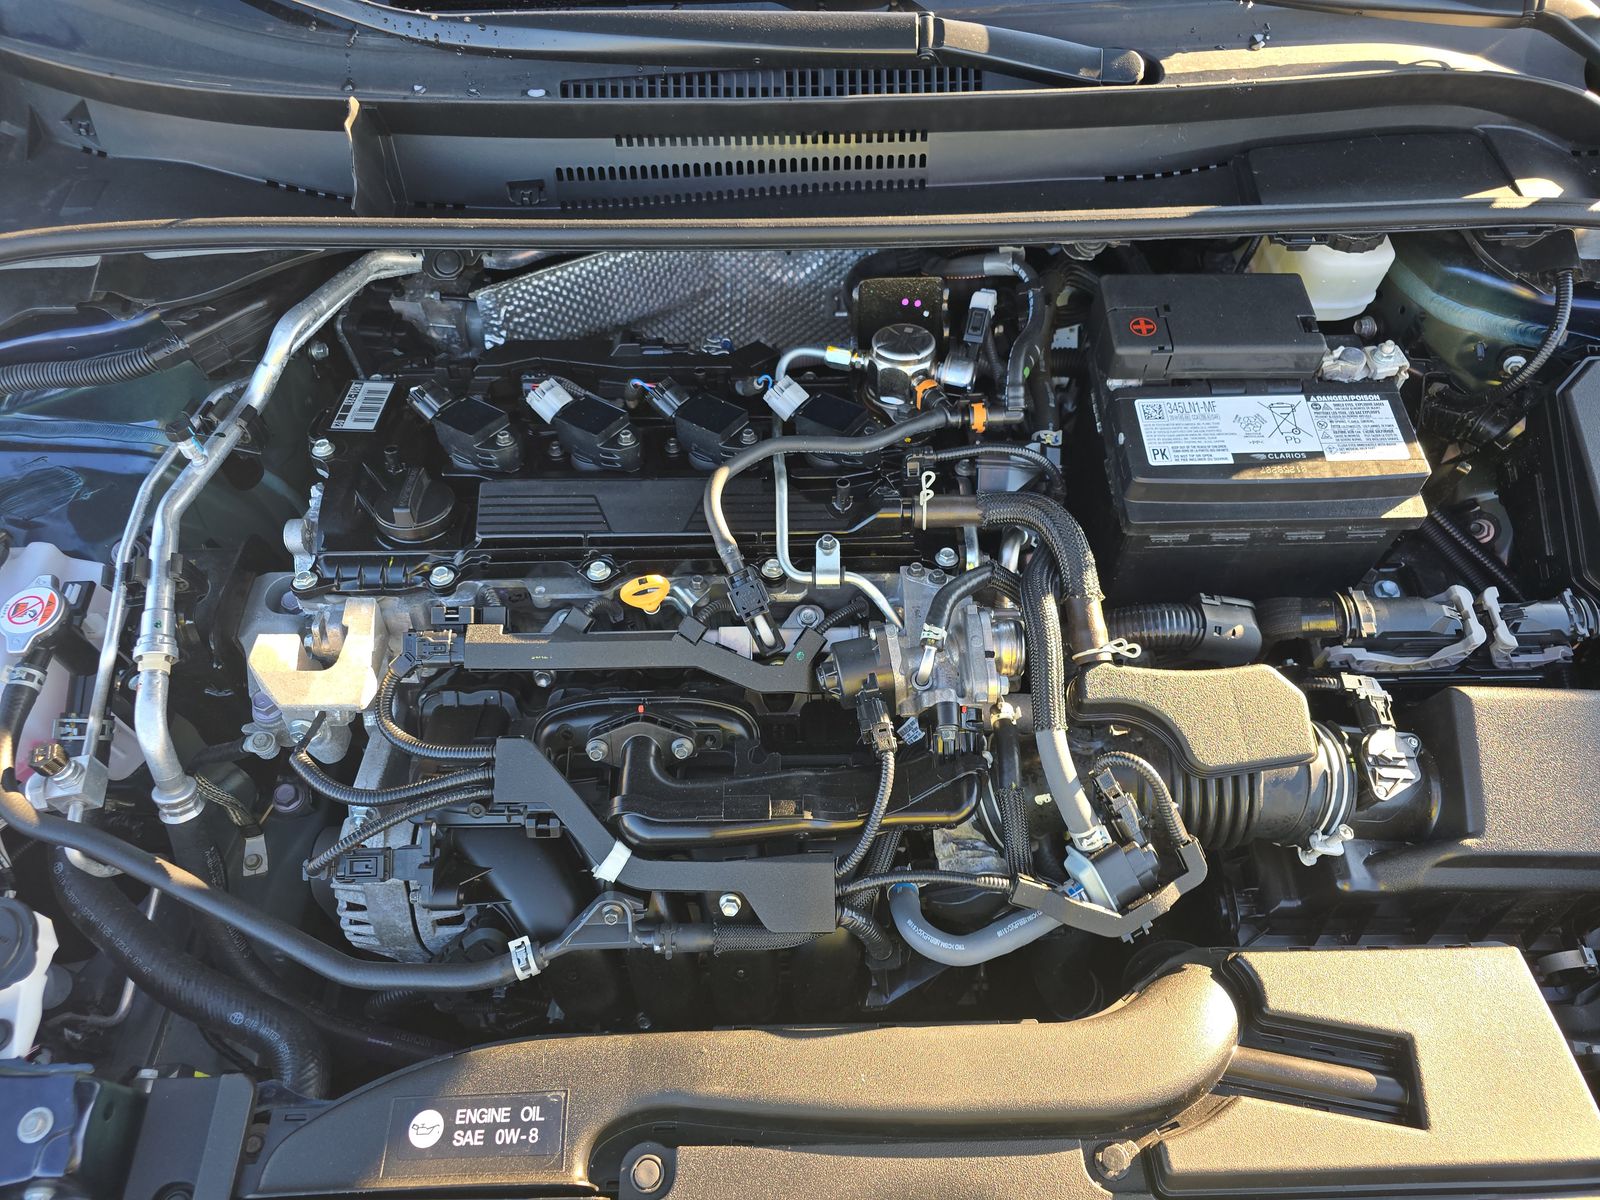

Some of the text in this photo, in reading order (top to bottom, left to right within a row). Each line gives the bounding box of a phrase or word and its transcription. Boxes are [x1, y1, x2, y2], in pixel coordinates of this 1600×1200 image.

[1166, 401, 1217, 414] 345LN1-MF
[1284, 436, 1301, 444] Pb
[1152, 448, 1169, 460] PK
[455, 1106, 545, 1125] ENGINE OIL
[452, 1127, 539, 1146] SAE 0W-8
